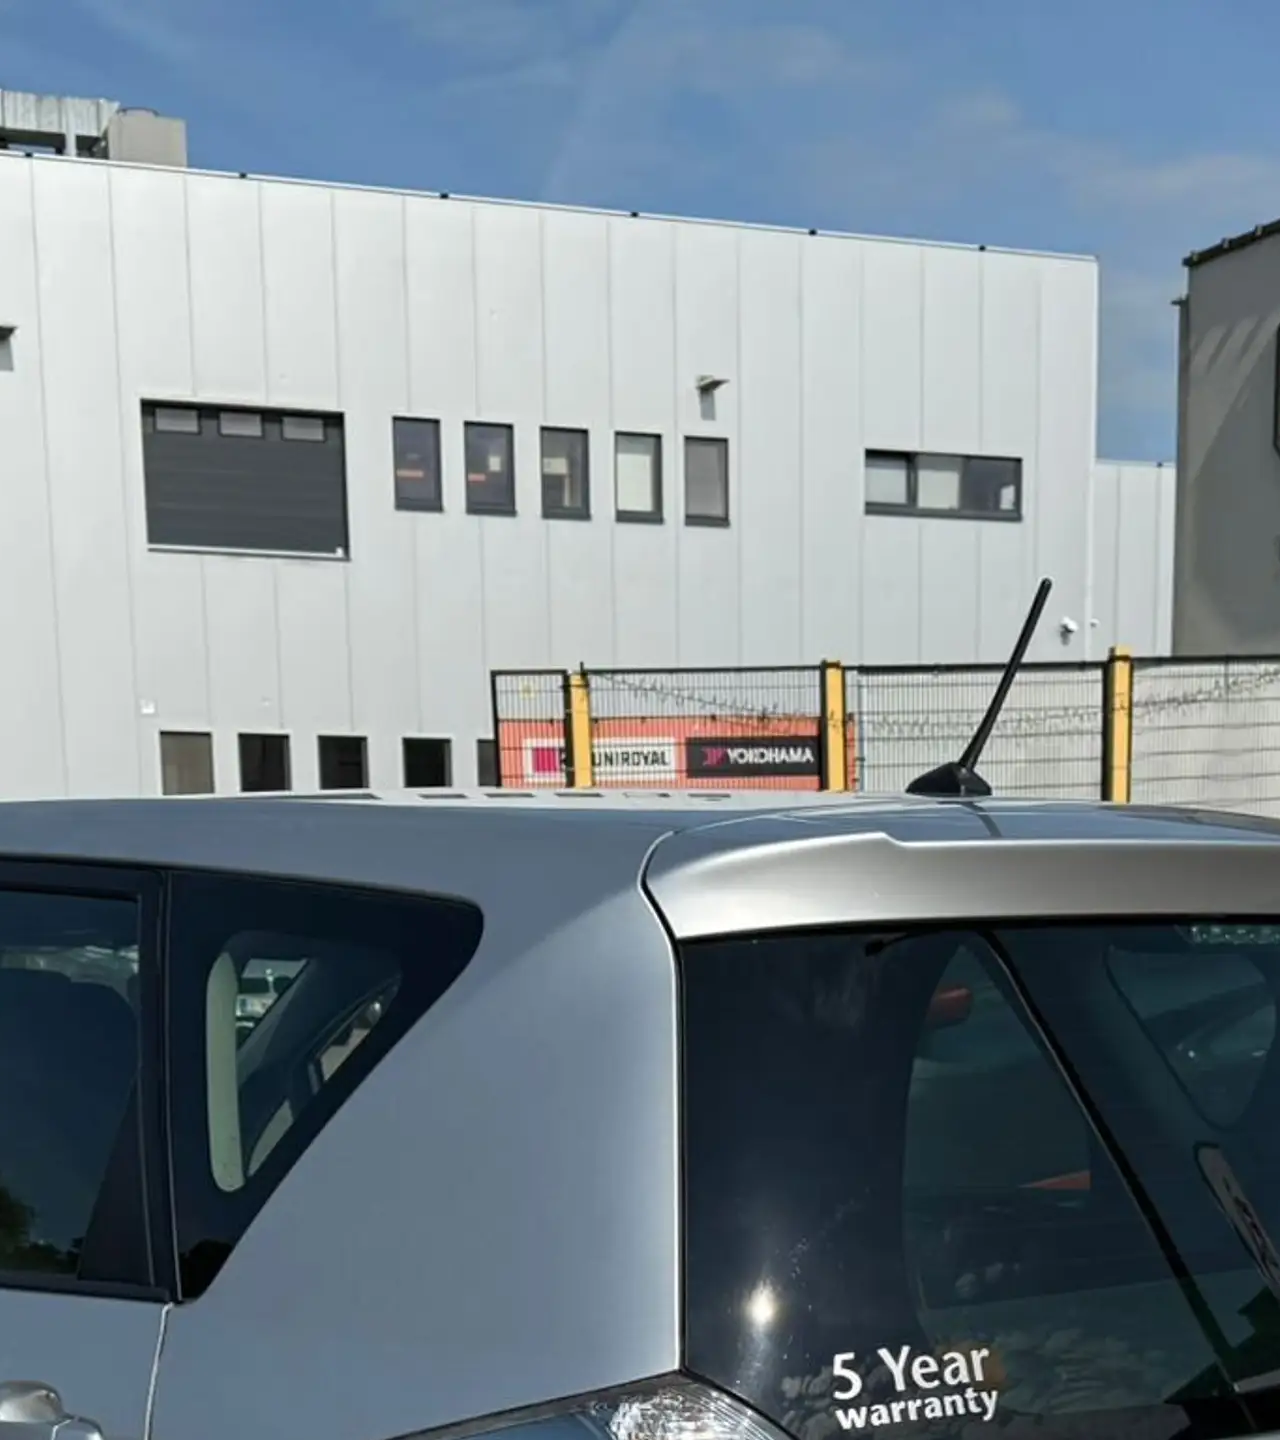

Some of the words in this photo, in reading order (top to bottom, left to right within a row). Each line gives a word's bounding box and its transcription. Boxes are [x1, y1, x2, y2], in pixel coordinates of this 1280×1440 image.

[593, 750, 669, 767] UNIROYAL
[727, 747, 815, 765] YOKOHAMA
[832, 1351, 863, 1401] 5
[877, 1345, 990, 1392] Year
[835, 1387, 999, 1431] warranty
